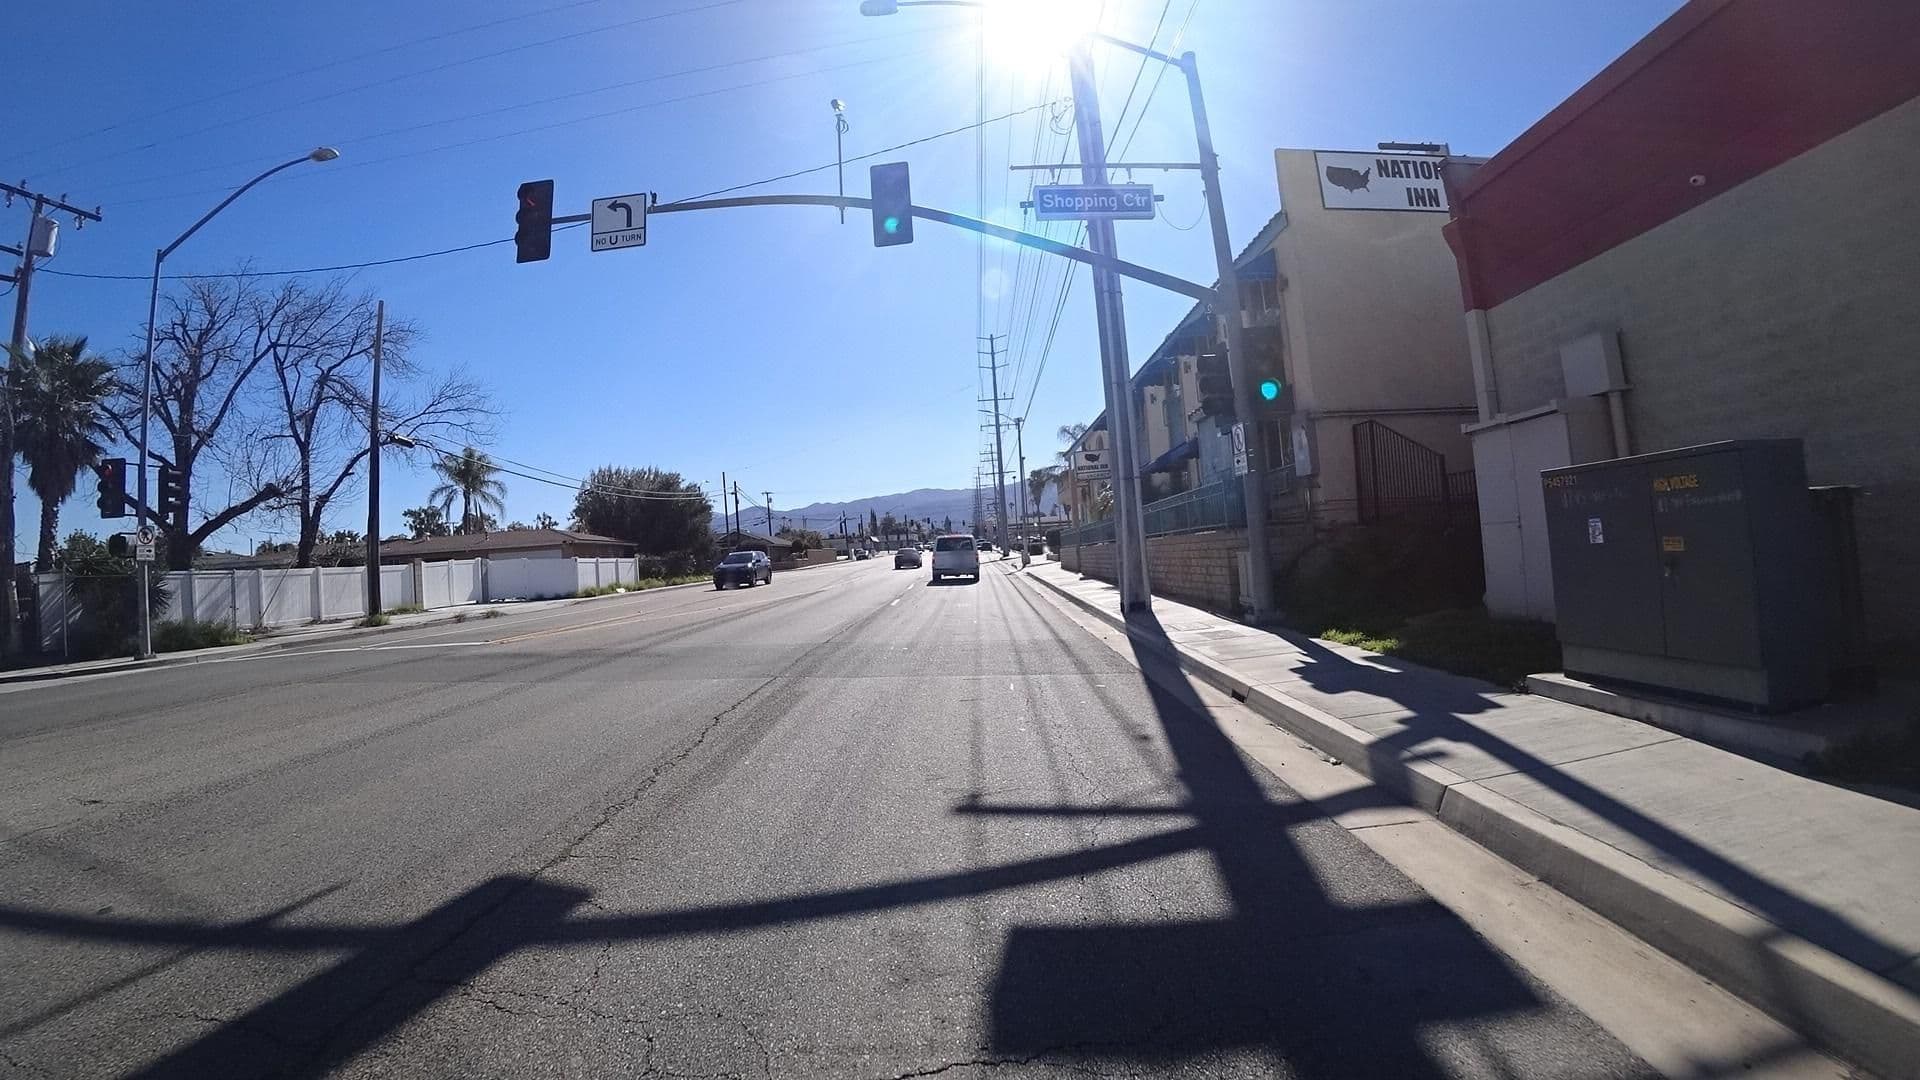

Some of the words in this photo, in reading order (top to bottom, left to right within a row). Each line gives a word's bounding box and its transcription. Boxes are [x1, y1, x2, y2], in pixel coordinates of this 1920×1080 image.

[1043, 194, 1118, 211] Shopping
[1123, 193, 1149, 207] Ctr
[1406, 187, 1441, 208] INN
[595, 239, 607, 247] NO
[609, 235, 618, 245] U
[621, 233, 642, 241] TURN
